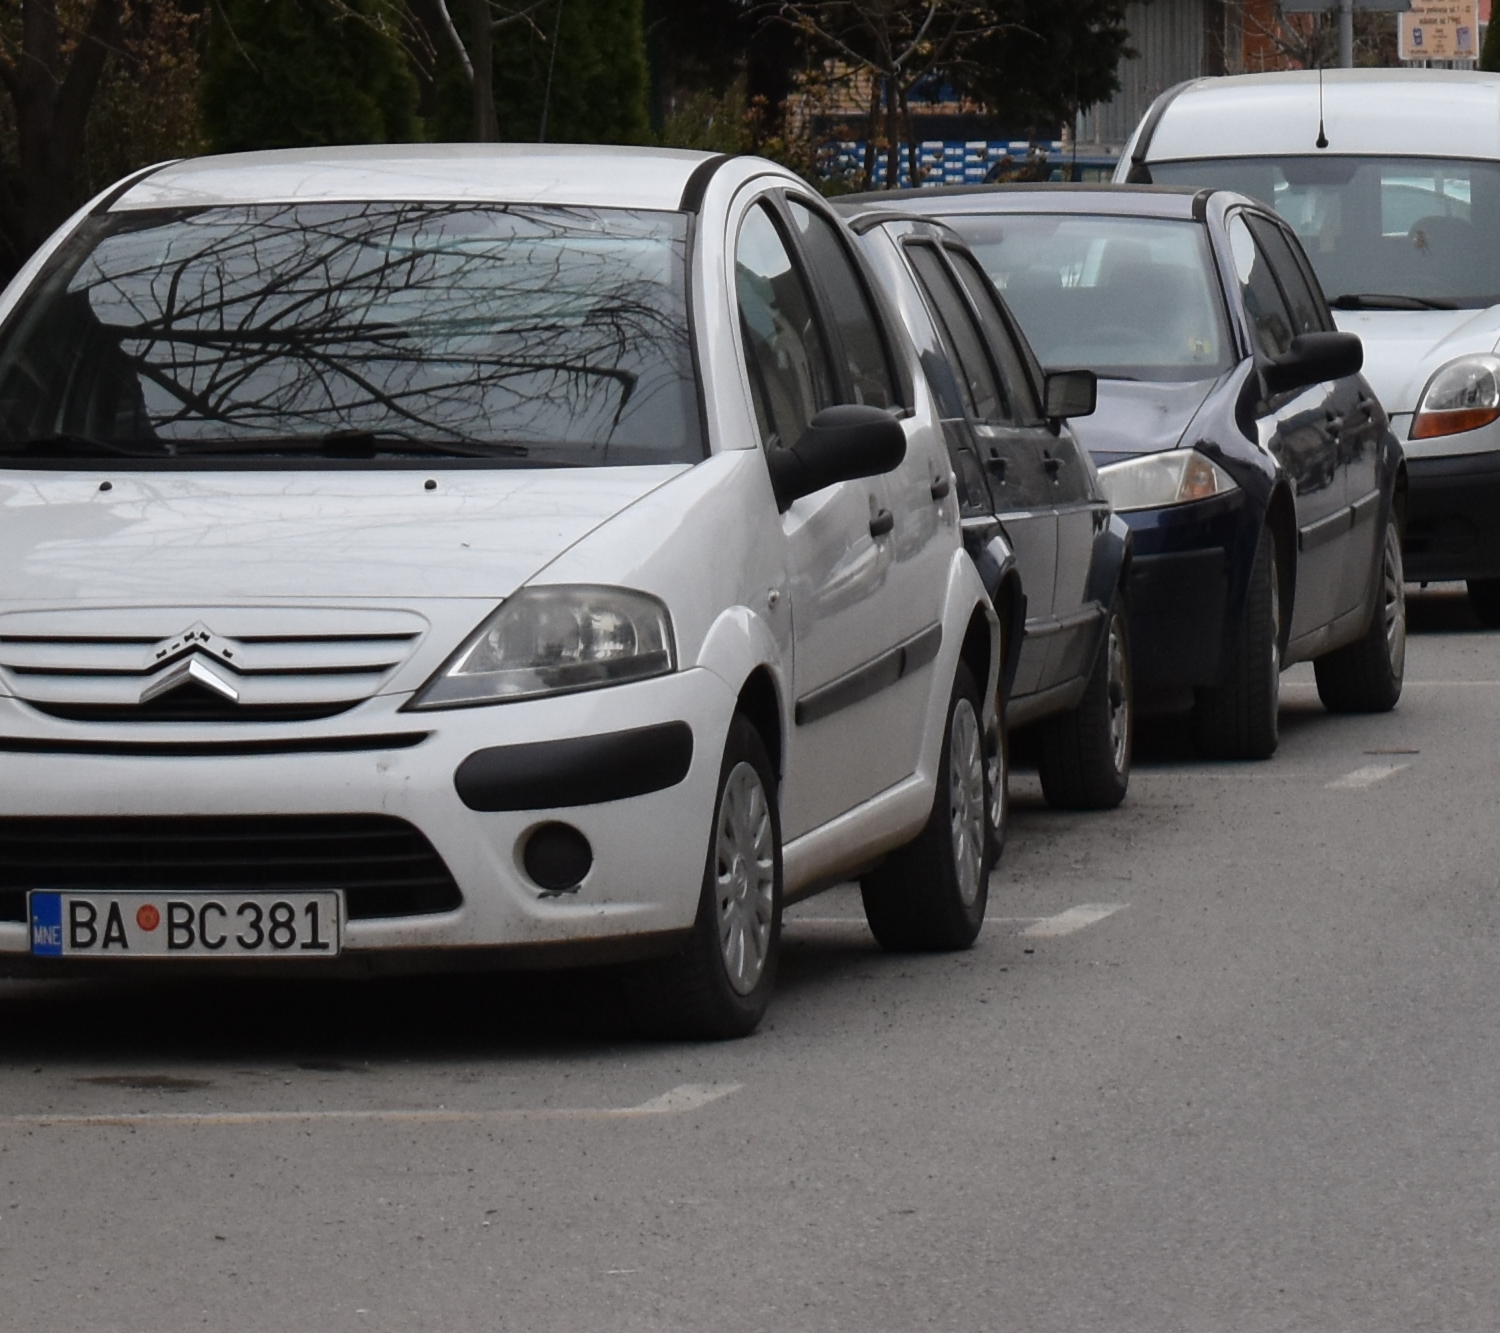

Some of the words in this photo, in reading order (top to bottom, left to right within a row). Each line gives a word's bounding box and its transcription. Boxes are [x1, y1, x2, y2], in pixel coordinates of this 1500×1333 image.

[34, 925, 61, 945] MNE
[69, 900, 129, 949] BA
[167, 900, 329, 949] BC381
